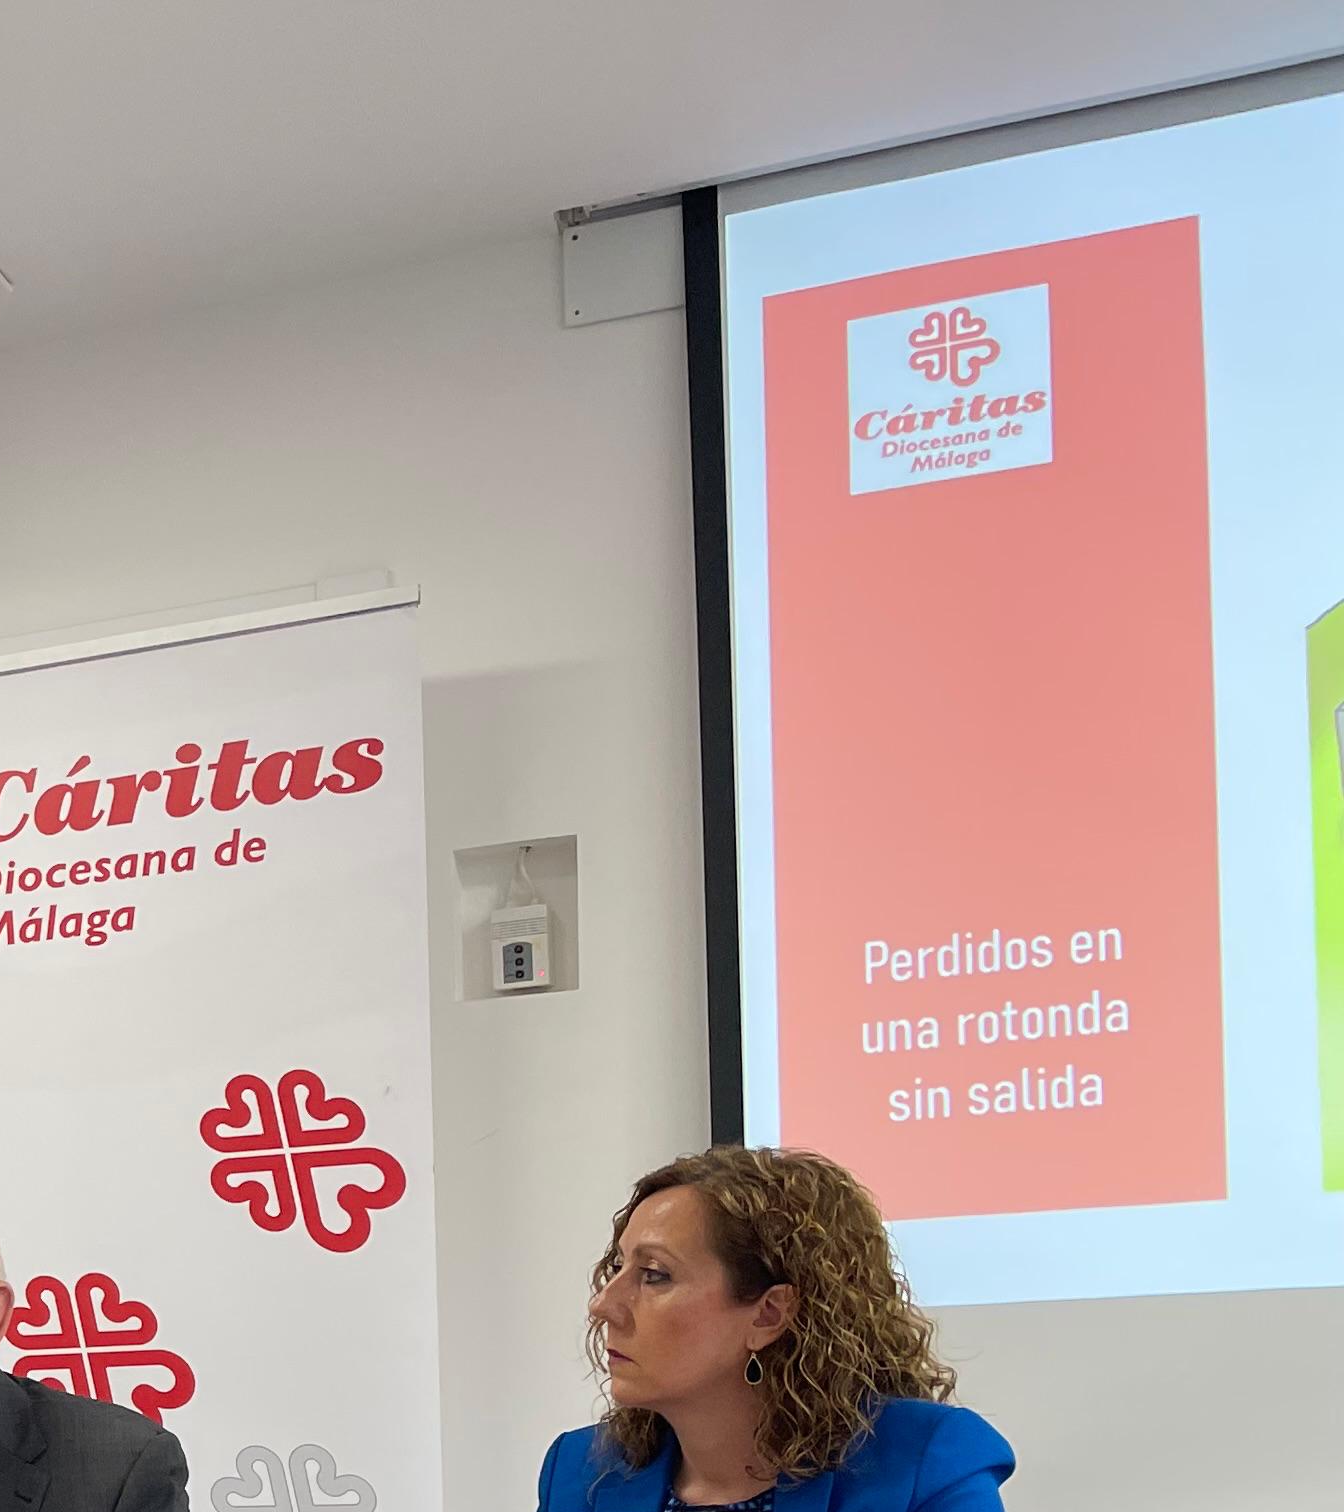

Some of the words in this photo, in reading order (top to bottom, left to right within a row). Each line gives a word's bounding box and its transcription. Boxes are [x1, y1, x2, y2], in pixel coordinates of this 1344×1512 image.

[854, 391, 1047, 441] Cáritas
[881, 428, 991, 459] Diocesana
[997, 421, 1023, 438] de
[910, 448, 991, 473] Málaga
[213, 828, 268, 867] de
[864, 928, 1054, 984] Perdidos
[1069, 928, 1123, 964] en
[861, 1016, 940, 1054] una
[957, 989, 1130, 1046] rotonda
[888, 1077, 951, 1122] sin
[967, 1064, 1104, 1116] salida
